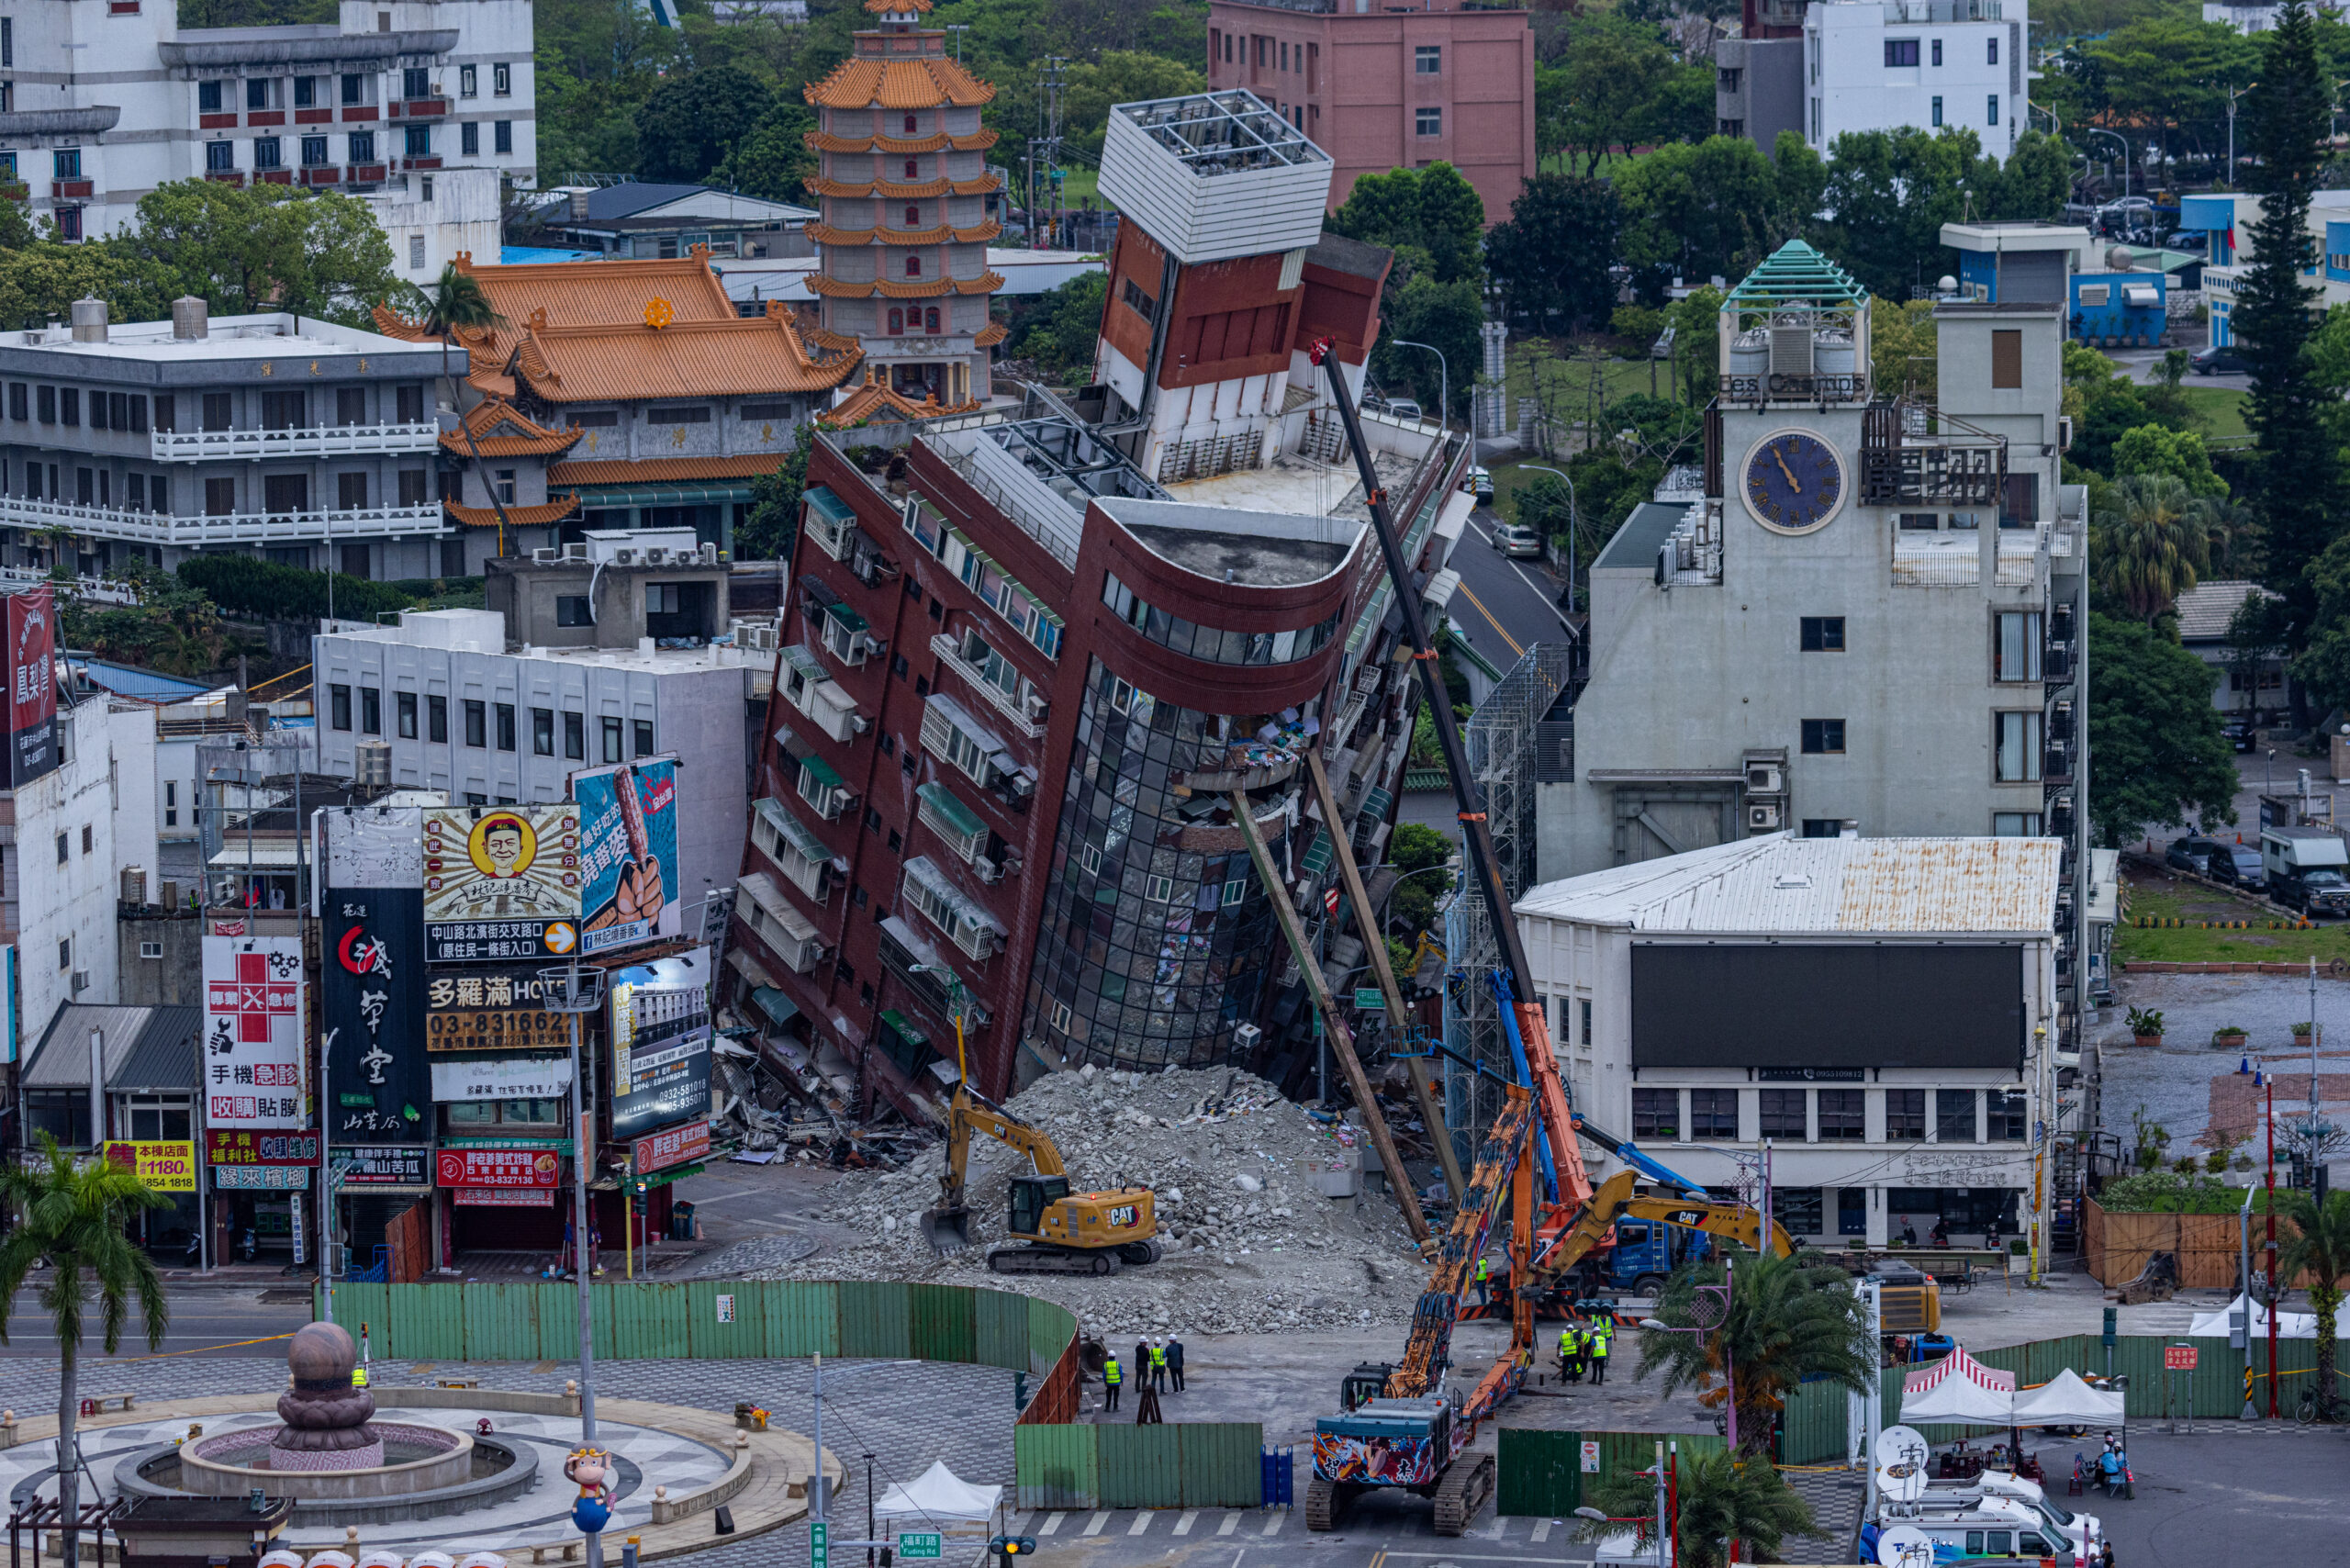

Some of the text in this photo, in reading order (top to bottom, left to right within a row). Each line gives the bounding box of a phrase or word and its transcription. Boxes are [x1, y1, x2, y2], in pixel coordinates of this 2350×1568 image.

[581, 801, 622, 850] 最好吃的
[428, 822, 442, 890] 僅此一家
[563, 818, 576, 885] 別無分號
[342, 902, 368, 917] 花蓮
[431, 922, 543, 941] 中山路北濱街交叉路口
[438, 940, 537, 958] (原住民一條街入口)
[210, 991, 297, 1007] 專業 急修
[428, 976, 512, 1008] 多羅滿
[211, 1064, 297, 1086] 手機急診
[659, 1078, 707, 1103] 0932-581018
[213, 1097, 298, 1118] 收購貼膜
[342, 1109, 401, 1130] 山苦瓜
[139, 1145, 189, 1158] 本棟店面
[217, 1132, 318, 1159] 手機 收購維修
[211, 1148, 258, 1163] 福利社
[466, 1152, 533, 1166] 胖老爹美式炸雞
[147, 1159, 185, 1175] 1180
[168, 1178, 193, 1187] 1818
[219, 1167, 306, 1188] 緣來檳榔
[484, 1176, 533, 1184] 03-8327130
[1110, 1205, 1133, 1226] CAT
[1678, 1211, 1698, 1226] CAT
[903, 1535, 937, 1547] 福町路
[903, 1548, 925, 1556] Fuding
